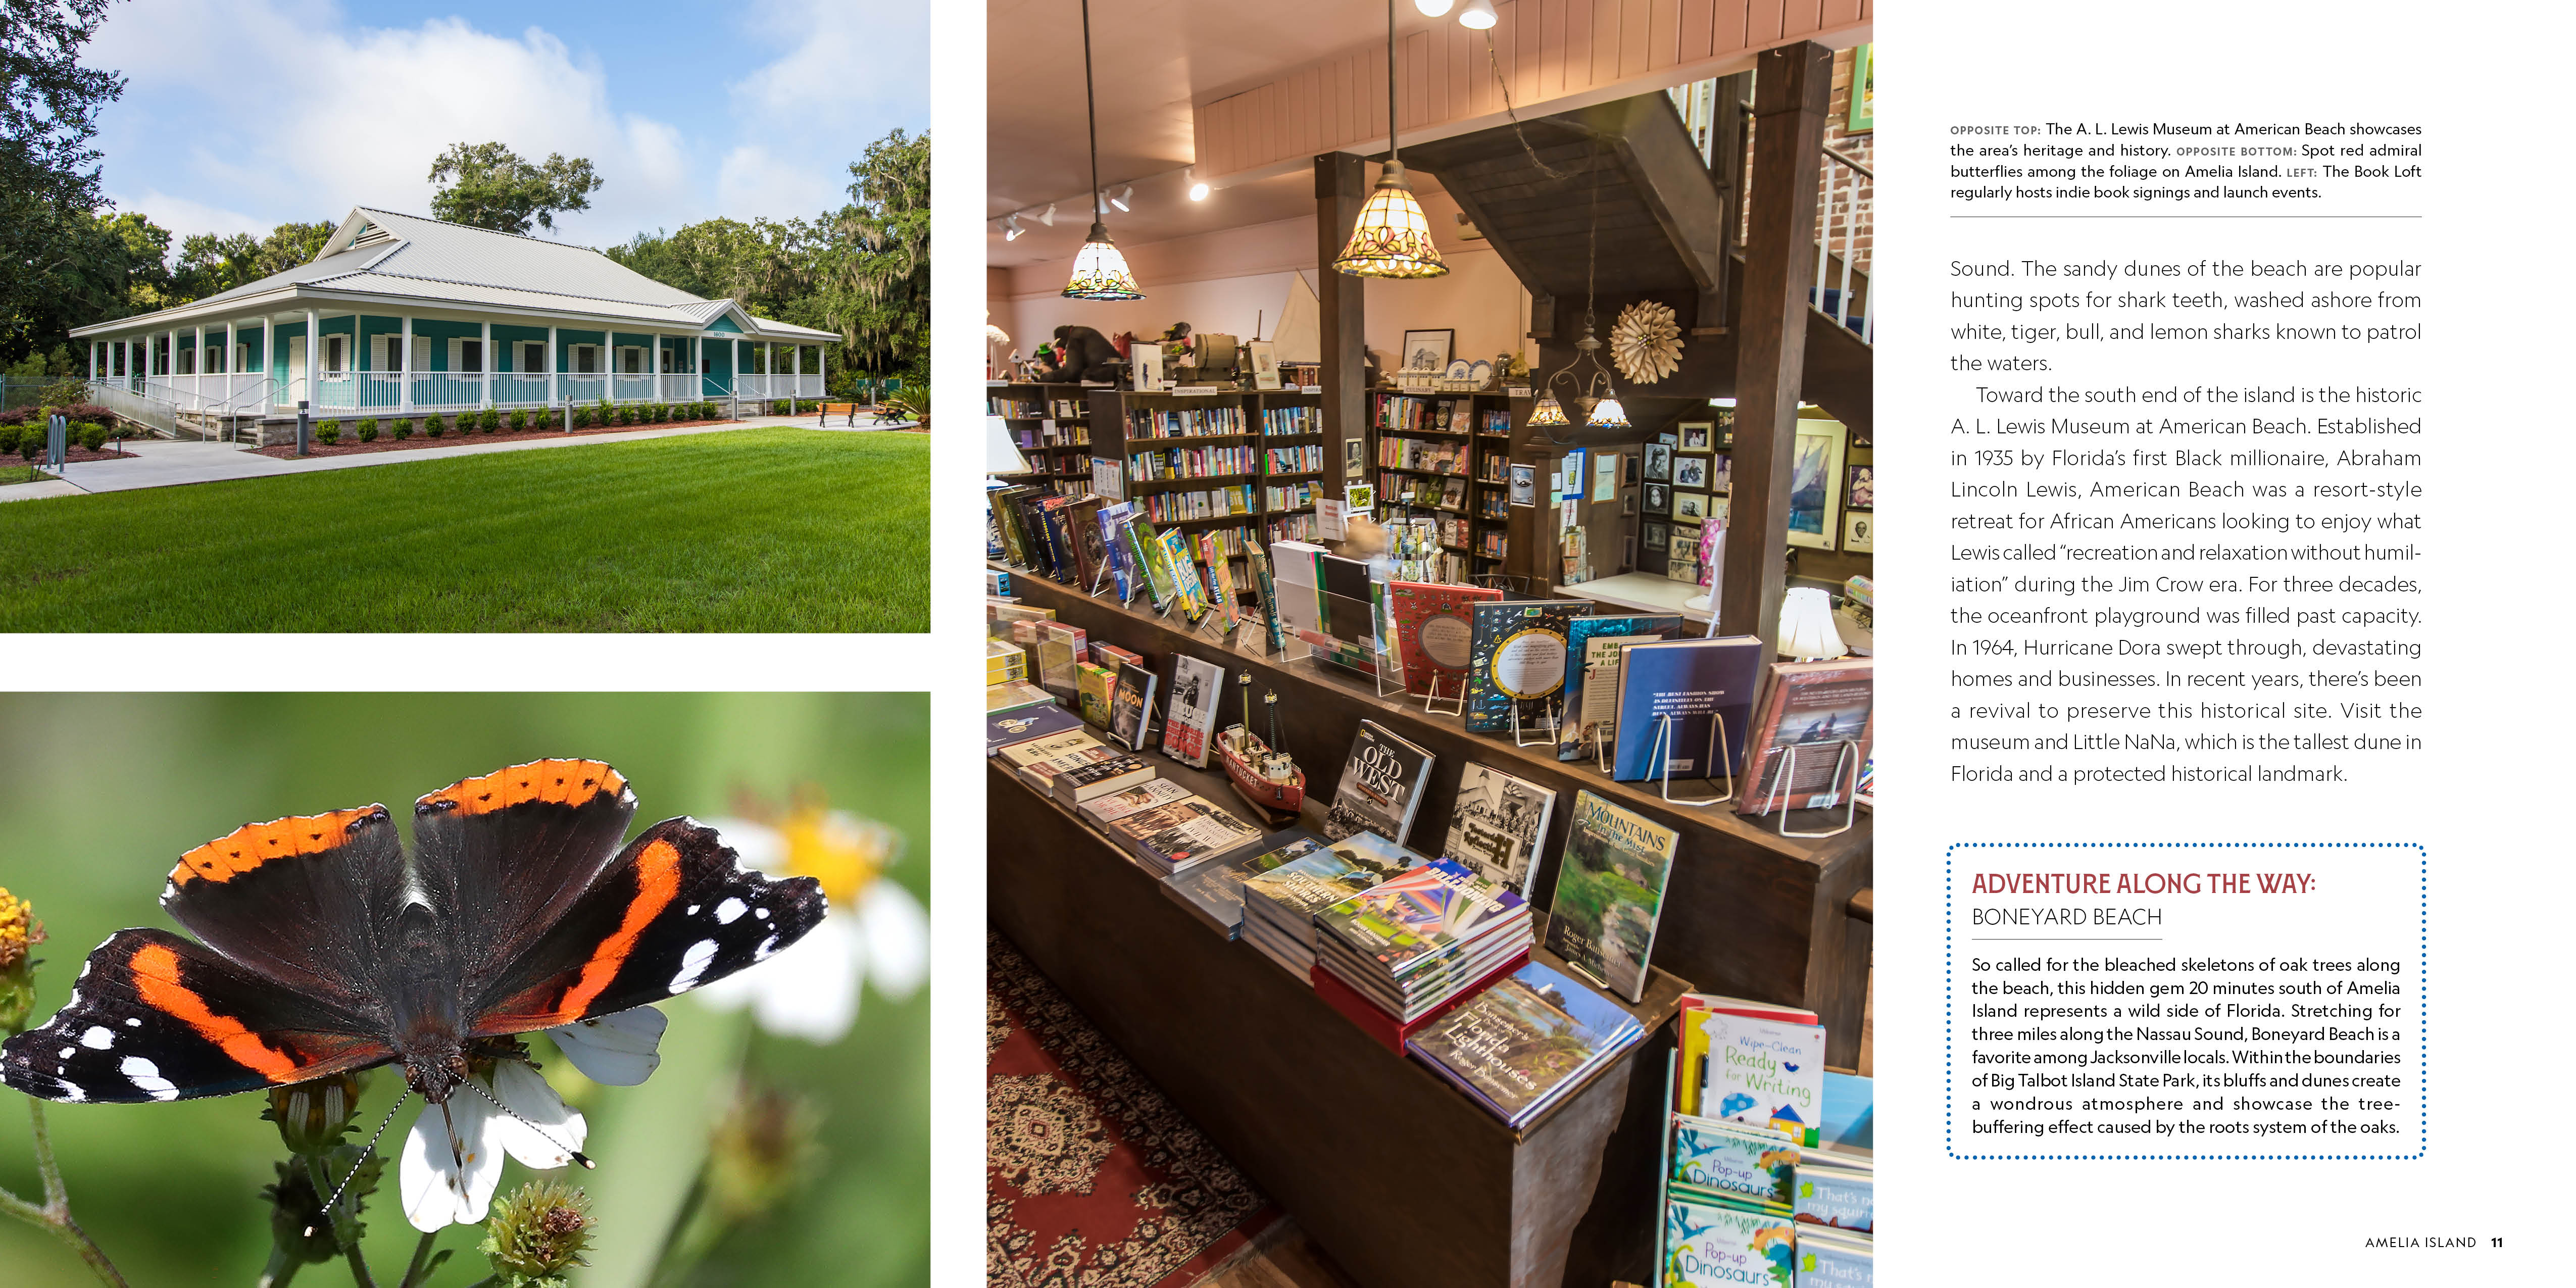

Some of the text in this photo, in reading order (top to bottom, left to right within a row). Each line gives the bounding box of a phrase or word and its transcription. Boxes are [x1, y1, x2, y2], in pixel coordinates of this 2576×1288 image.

[1950, 122, 2422, 135] OPPOSITE TOP: The A. L. Lewis Museum at American Beach showcases
[1950, 143, 1974, 156] the
[2024, 143, 2083, 159] heritage
[2089, 143, 2114, 156] and
[2121, 143, 2171, 159] history.
[2176, 147, 2235, 156] OPPOSITE
[2241, 147, 2297, 156] BOTTOM:
[2302, 144, 2335, 159] Spot
[2341, 143, 2363, 156] red
[2369, 143, 2421, 156] admiral
[1950, 354, 2052, 371] the waters.
[1229, 496, 1243, 505] BIG
[1952, 480, 2422, 501] Lincoln Lewis, American Beach was a resort-style
[1265, 592, 1276, 617] Animals
[1119, 687, 1143, 709] MOON
[1170, 700, 1208, 721] BRUCE
[1168, 719, 1180, 728] THE
[1165, 732, 1202, 759] SONGS
[1380, 743, 1395, 758] THE
[1085, 767, 1103, 776] CROW
[1226, 755, 1258, 787] NANTUCKET
[1364, 747, 1402, 779] OLD
[1158, 783, 1179, 794] SEAN
[1354, 756, 1406, 804] WEST
[1142, 783, 1175, 800] HANNITY
[1577, 801, 1665, 851] MOUNTAINS
[1598, 823, 1646, 855] In The Mist
[1282, 880, 1322, 903] SHORES
[1286, 872, 1339, 903] SOUTHERN
[1425, 867, 1506, 913] BALLOONING
[1971, 873, 2315, 894] ADVENTURE ALONG THE WAY:
[1973, 908, 2161, 925] BONEYARD BEACH
[1564, 925, 1585, 945] Roger
[1565, 944, 1581, 958] James
[1454, 1010, 1510, 1053] Florida
[1740, 1035, 1802, 1055] Wipe-Clean
[1444, 1022, 1538, 1090] Lighthouses
[1450, 1049, 1477, 1069] Roger
[1726, 1045, 1777, 1078] Ready
[1725, 1068, 1741, 1081] for
[1746, 1072, 1811, 1108] Writing
[1713, 1159, 1753, 1181] Pop-up
[1693, 1168, 1773, 1199] Dinosaurs
[1807, 1202, 1828, 1217] my
[2365, 1237, 2502, 1248] AMELIA ISLAND 11
[1705, 1242, 1747, 1267] Pop-up
[1686, 1254, 1769, 1286] Dinosaurs
